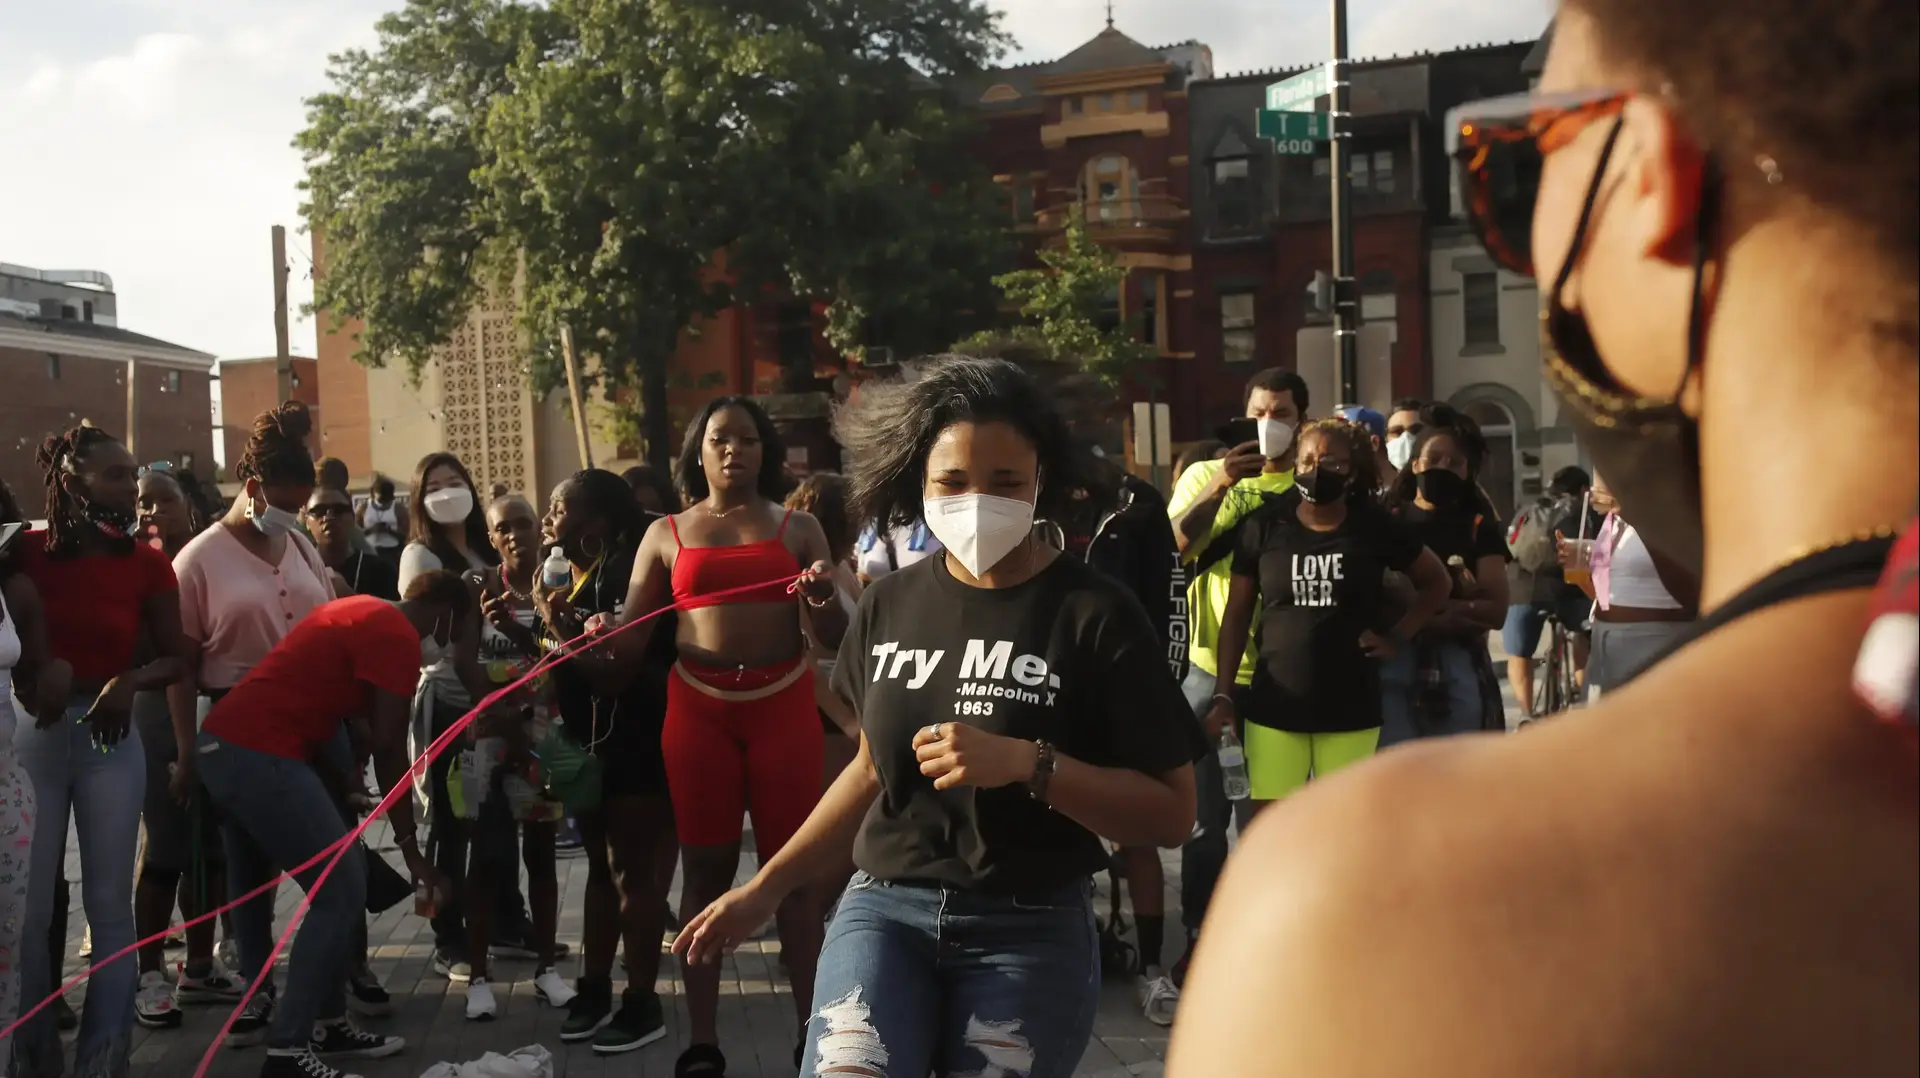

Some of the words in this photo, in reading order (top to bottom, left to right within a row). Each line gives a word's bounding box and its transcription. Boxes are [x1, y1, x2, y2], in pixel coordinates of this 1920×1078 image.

[1279, 113, 1288, 135] T
[1277, 139, 1313, 154] 600
[1292, 553, 1344, 580] LOVE
[1292, 580, 1337, 606] HER.
[872, 641, 945, 690] Try
[958, 639, 1061, 689] Me.
[953, 701, 994, 716] 1963
[1045, 691, 1056, 707] X
